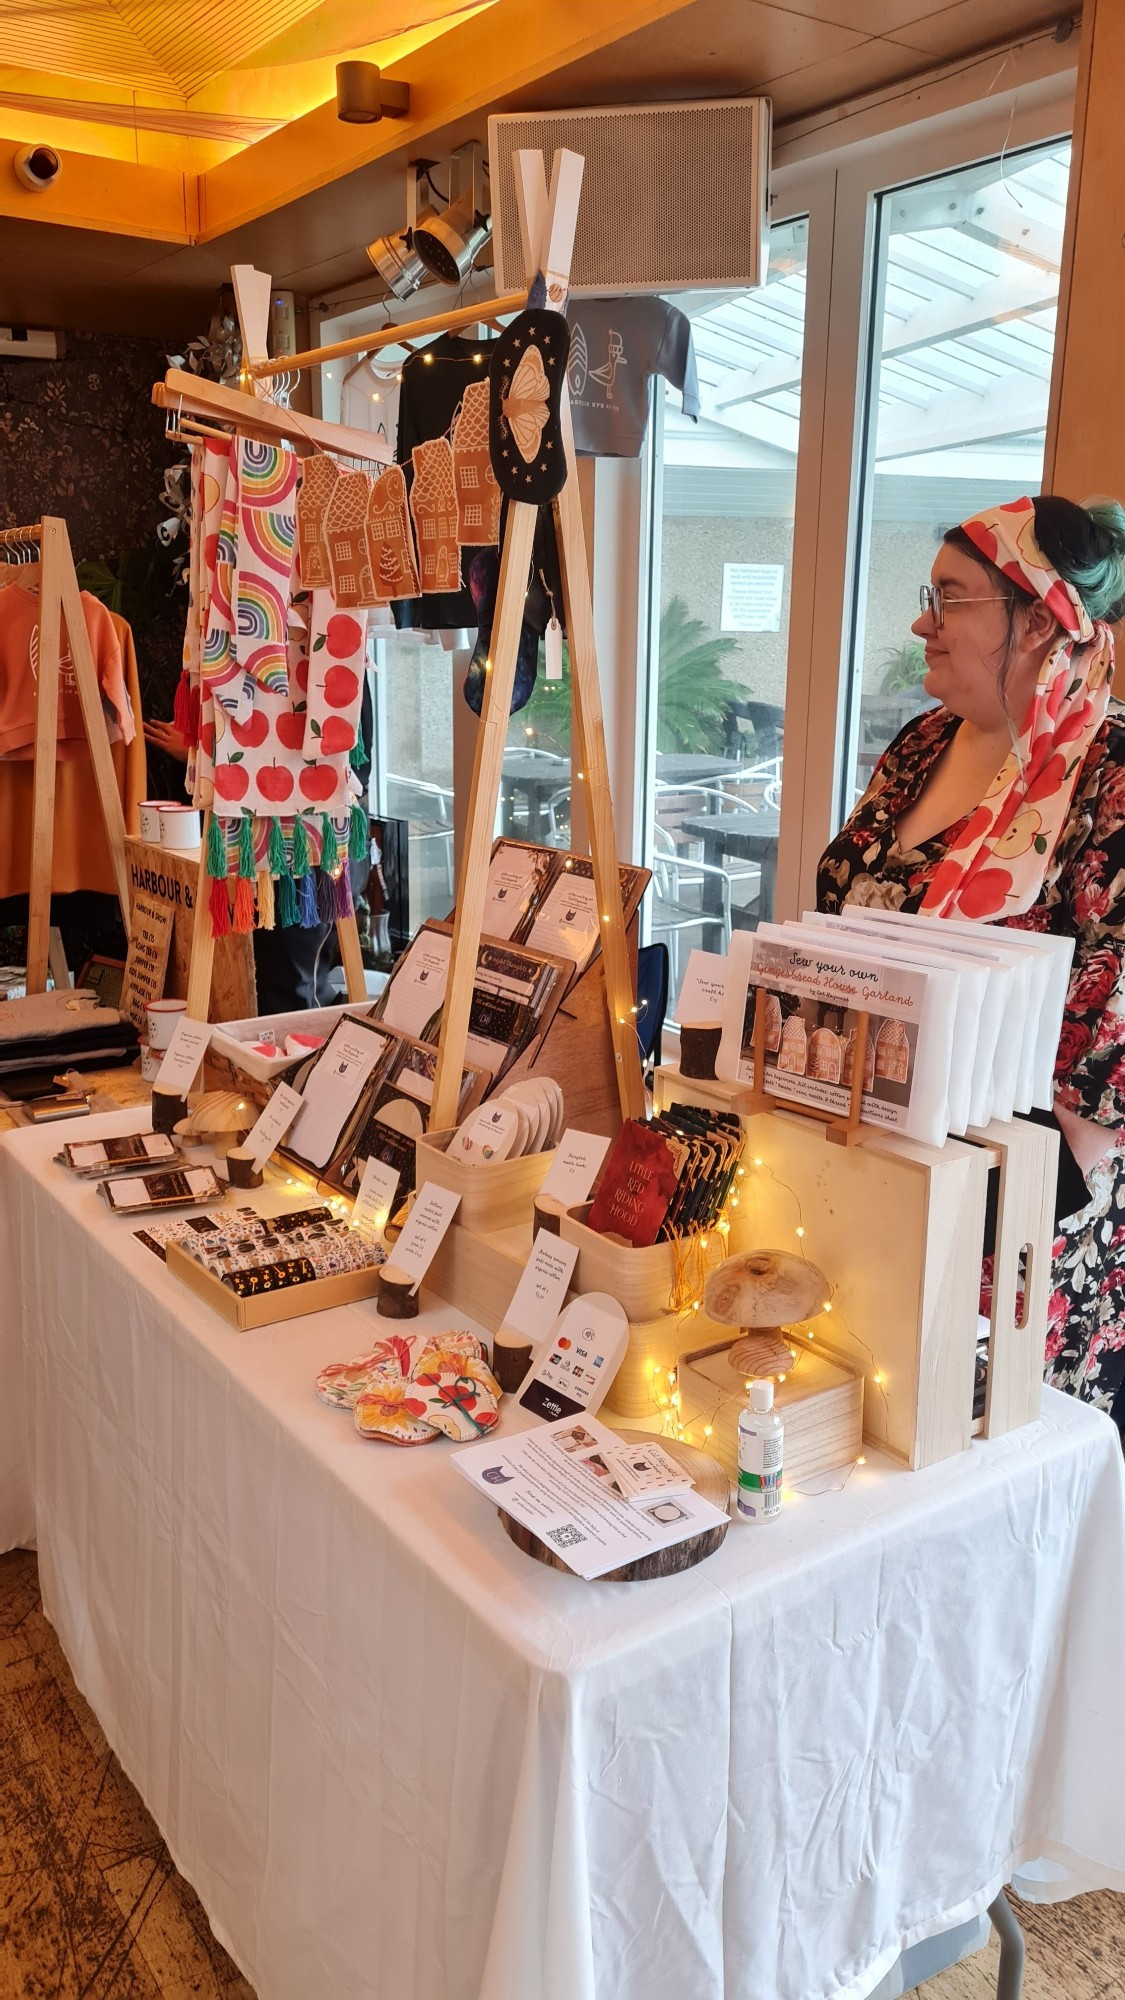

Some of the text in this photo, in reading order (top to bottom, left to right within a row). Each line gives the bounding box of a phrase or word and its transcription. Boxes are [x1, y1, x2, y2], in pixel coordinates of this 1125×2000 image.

[131, 863, 193, 909] HARBOUR &
[790, 952, 879, 983] Sew your own
[710, 981, 725, 989] your
[757, 961, 913, 1007] Gingerbread House Garland
[829, 1098, 847, 1108] thread
[860, 1108, 884, 1119] ructions
[866, 1102, 881, 1110] with
[880, 1105, 898, 1115] design
[628, 1160, 654, 1181] LITTLE
[627, 1177, 645, 1195] RED
[614, 1187, 646, 1214] RIDING
[609, 1203, 638, 1227] HOOD
[534, 1265, 549, 1275] organic
[544, 1261, 554, 1269] made
[554, 1266, 564, 1274] with
[576, 1346, 588, 1359] VISA
[546, 1371, 554, 1381] Pay
[541, 1397, 562, 1415] Zettle
[486, 1470, 504, 1484] CH
